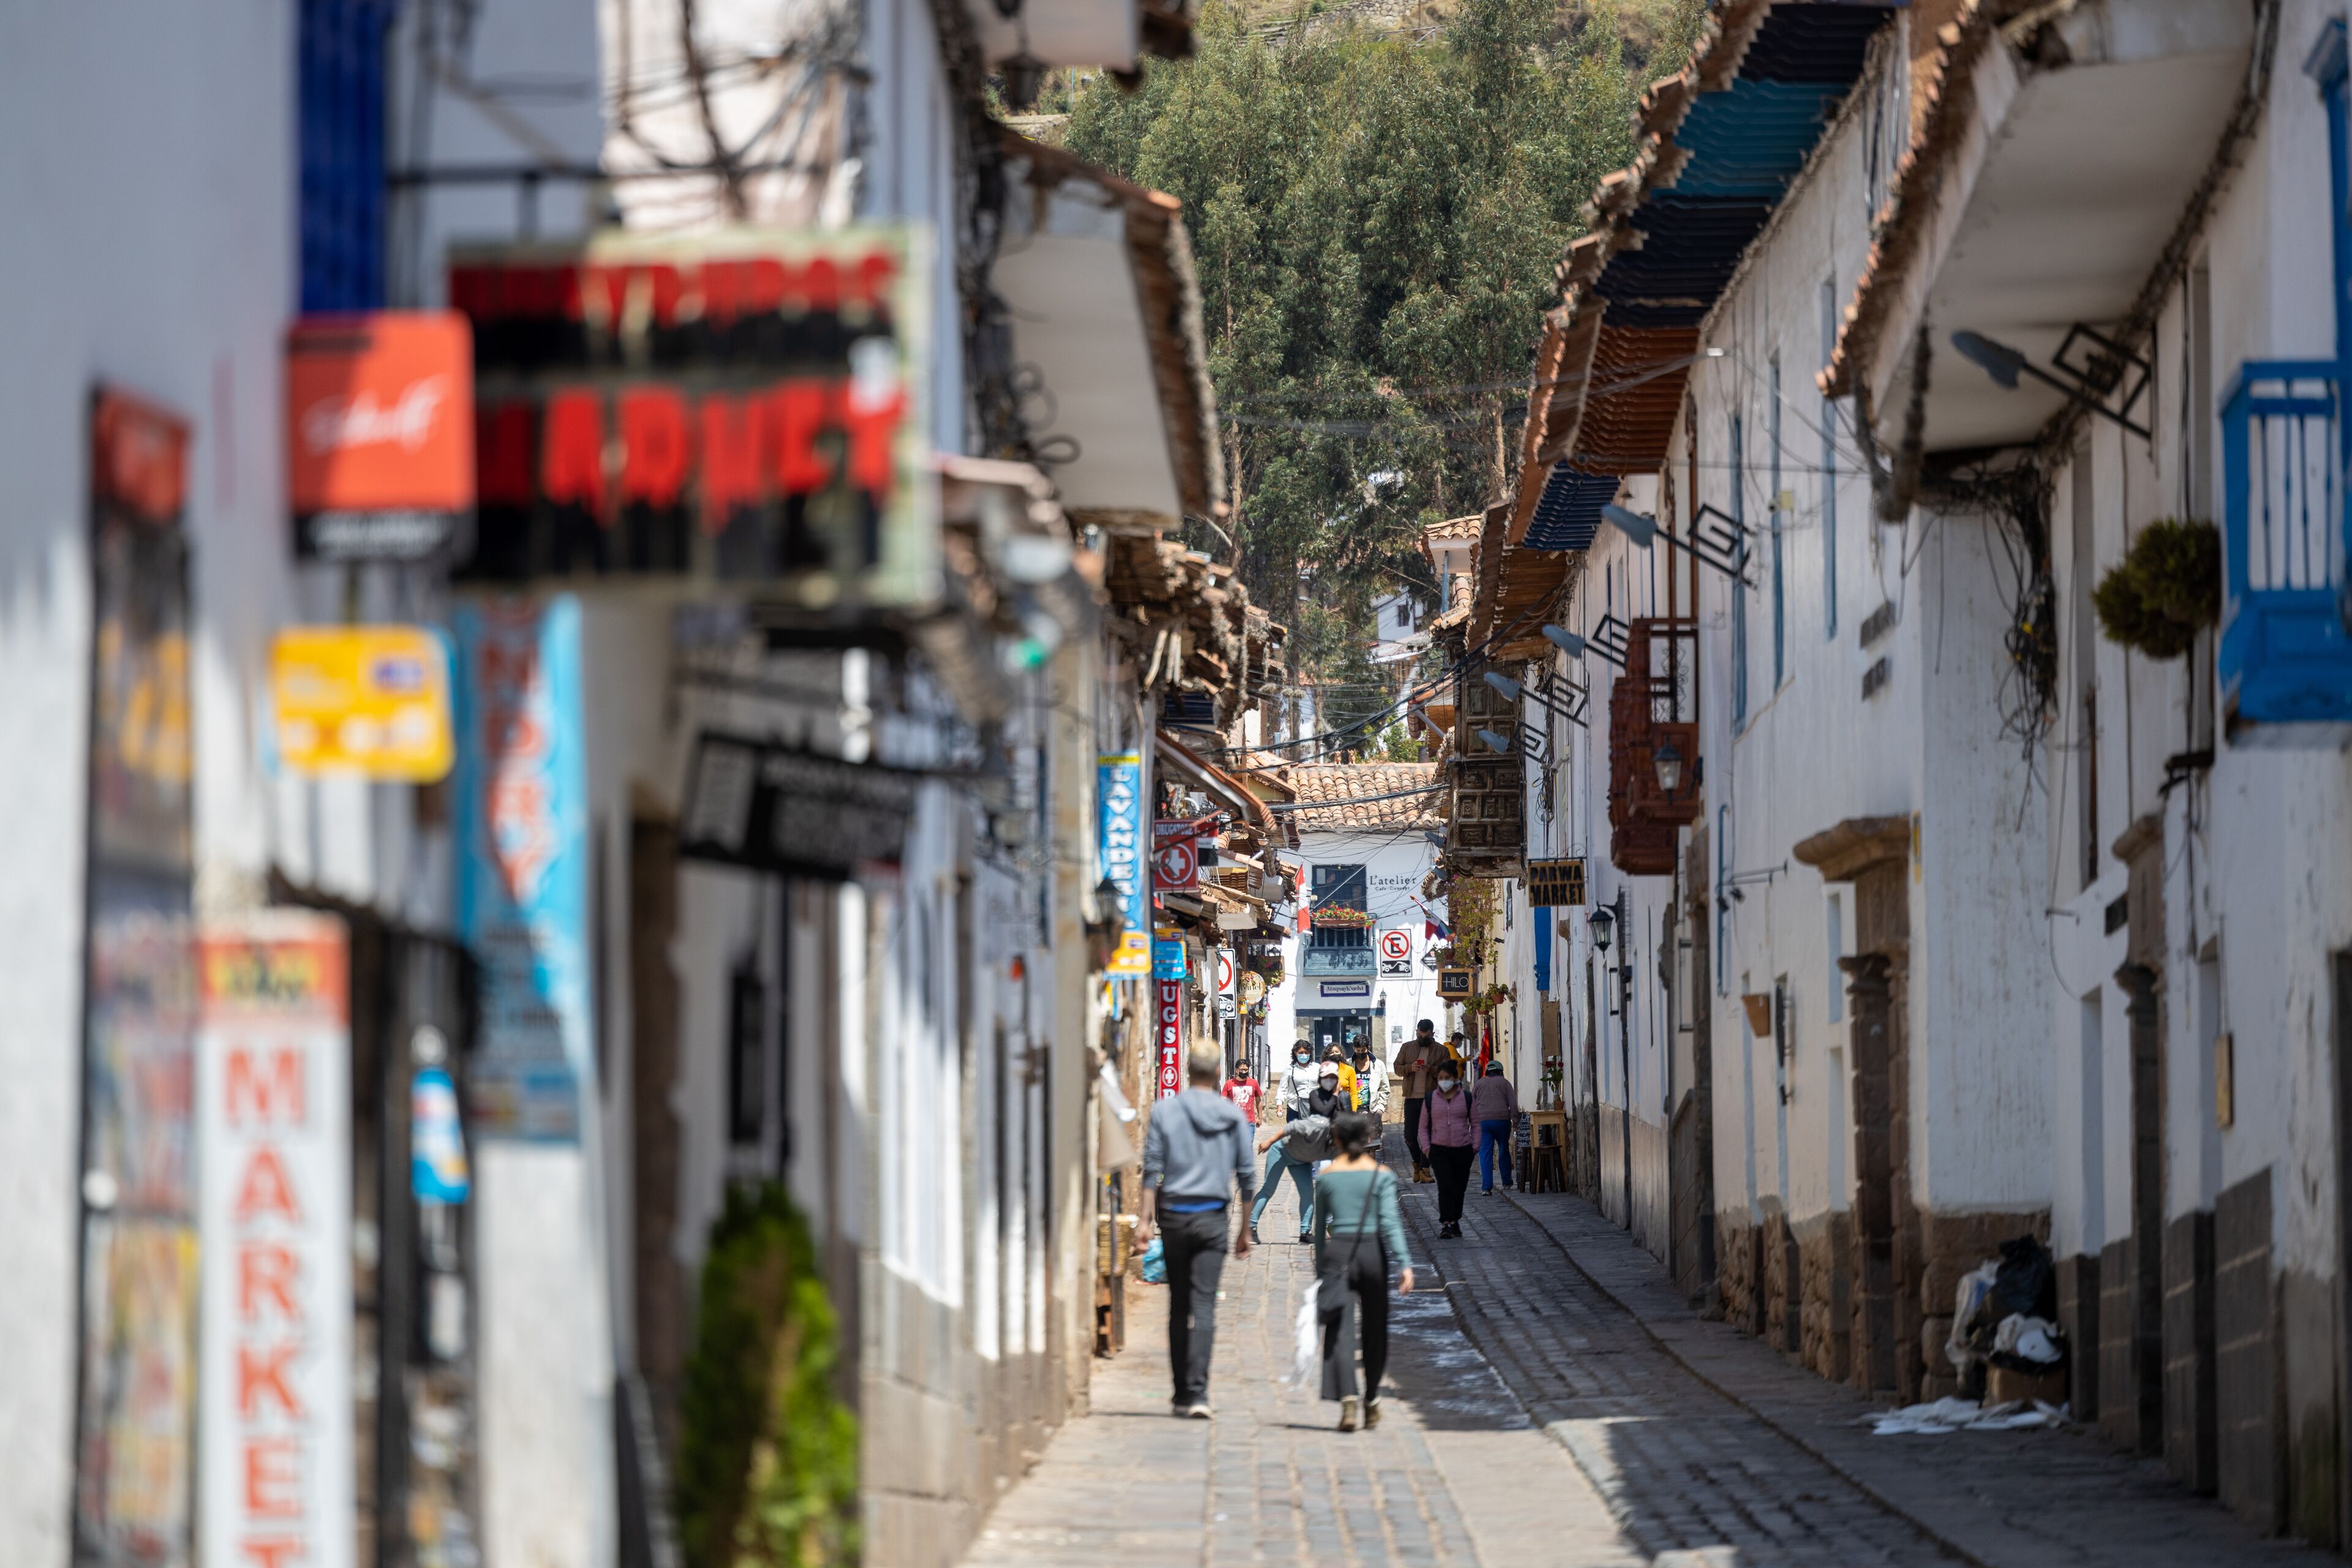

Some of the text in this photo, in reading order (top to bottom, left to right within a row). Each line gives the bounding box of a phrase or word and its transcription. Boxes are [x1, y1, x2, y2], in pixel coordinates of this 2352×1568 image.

[1370, 875, 1417, 885] L'atelier
[1529, 865, 1582, 882] PARWA
[1529, 883, 1585, 906] MARKET
[1442, 976, 1469, 988] HILO
